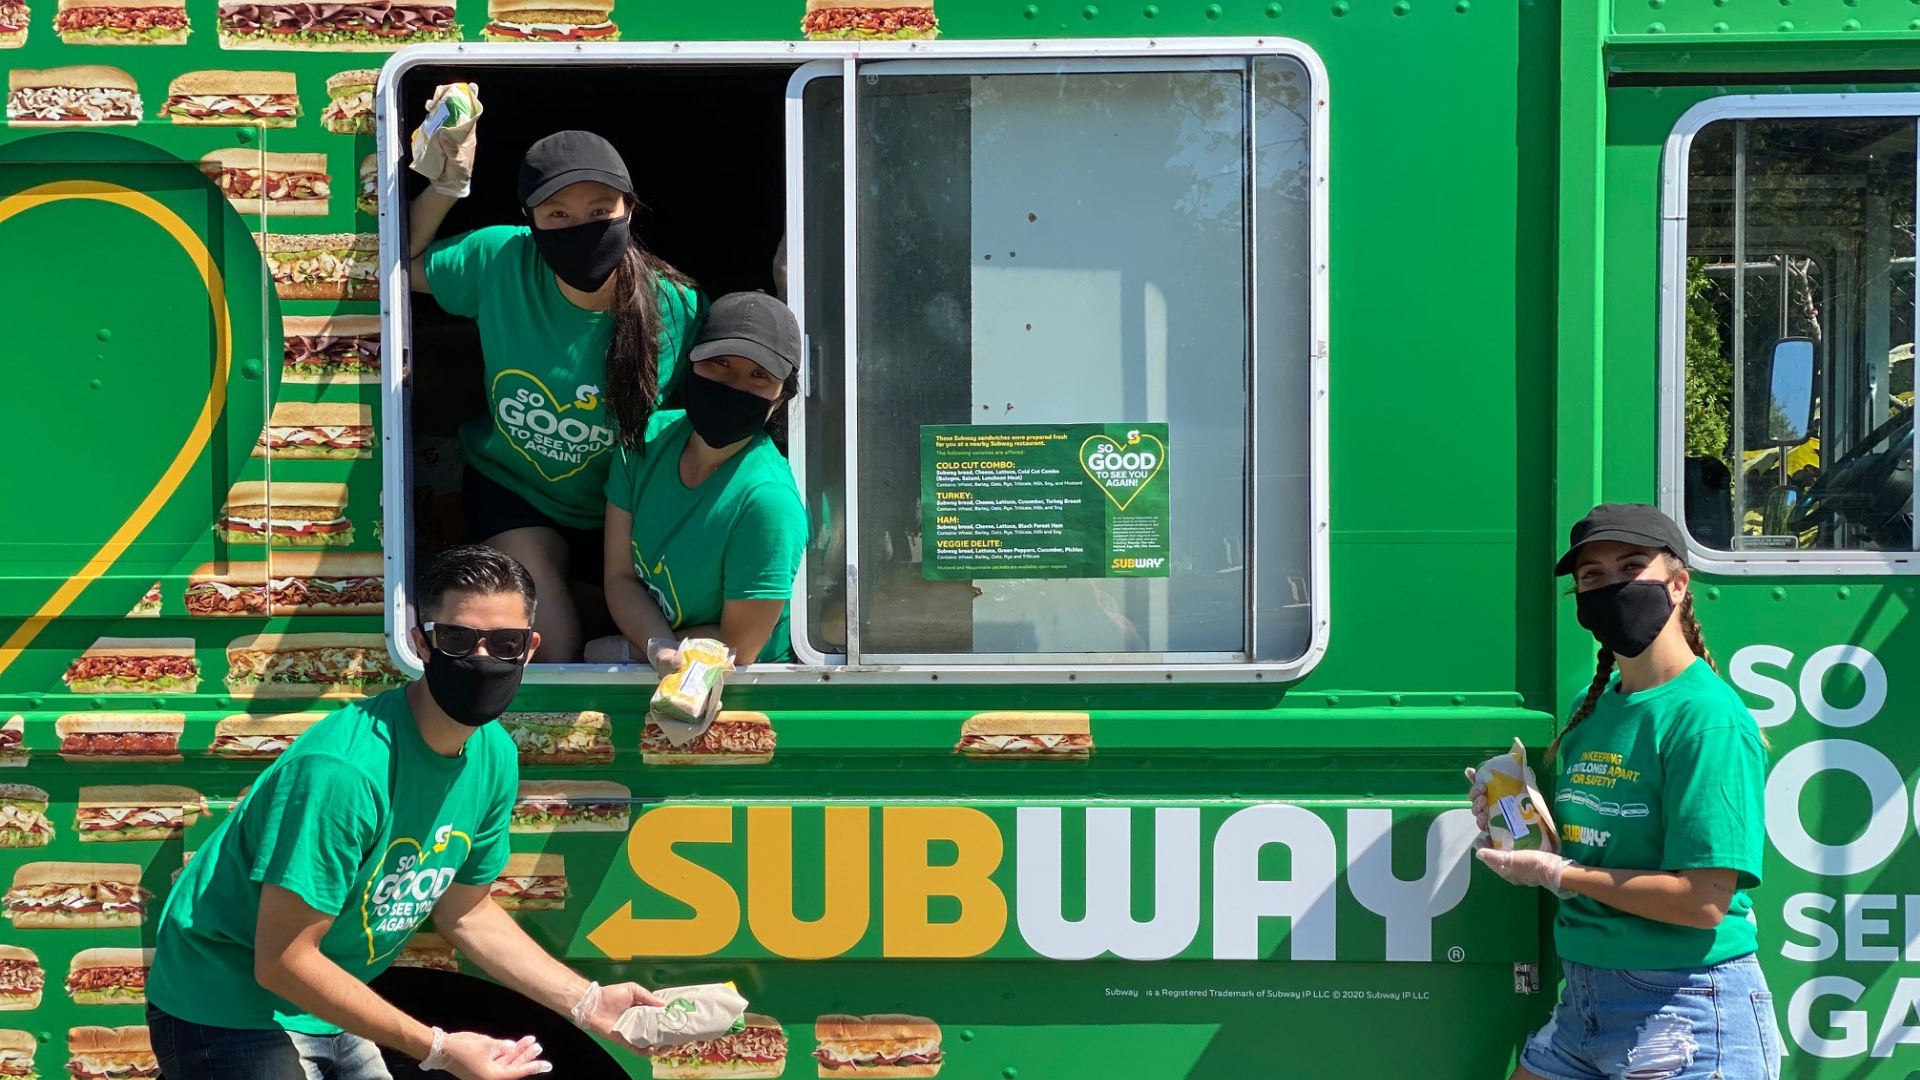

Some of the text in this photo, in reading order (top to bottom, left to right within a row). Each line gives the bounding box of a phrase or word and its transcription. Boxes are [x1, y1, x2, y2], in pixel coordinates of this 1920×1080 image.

[516, 389, 545, 407] SO
[499, 397, 614, 446] GOOD
[508, 426, 600, 453] TO SEE YOU
[524, 440, 581, 463] AGAIN!
[1097, 444, 1113, 453] SO
[980, 461, 1015, 469] COMBO:
[1088, 453, 1156, 470] GOOD
[1096, 471, 1109, 479] TO
[1106, 479, 1138, 487] AGAIN!
[937, 516, 959, 524] HAM:
[1111, 558, 1165, 569] SUBWAY
[1729, 644, 1888, 728] SO
[1585, 775, 1617, 789] SAFETY!
[1607, 766, 1641, 782] APART
[1562, 824, 1611, 847] SUBWAY
[396, 855, 416, 873] SO
[372, 867, 456, 904] GOOD
[586, 805, 1472, 961] SUBWAY
[389, 902, 413, 916] SEE
[1105, 988, 1139, 998] Subway
[1161, 989, 1208, 998] Registered
[1209, 989, 1255, 998] Trademark
[1256, 989, 1265, 998] of
[1267, 990, 1300, 999] Subway
[1342, 991, 1365, 999] 2020
[1366, 991, 1400, 1000] Subway
